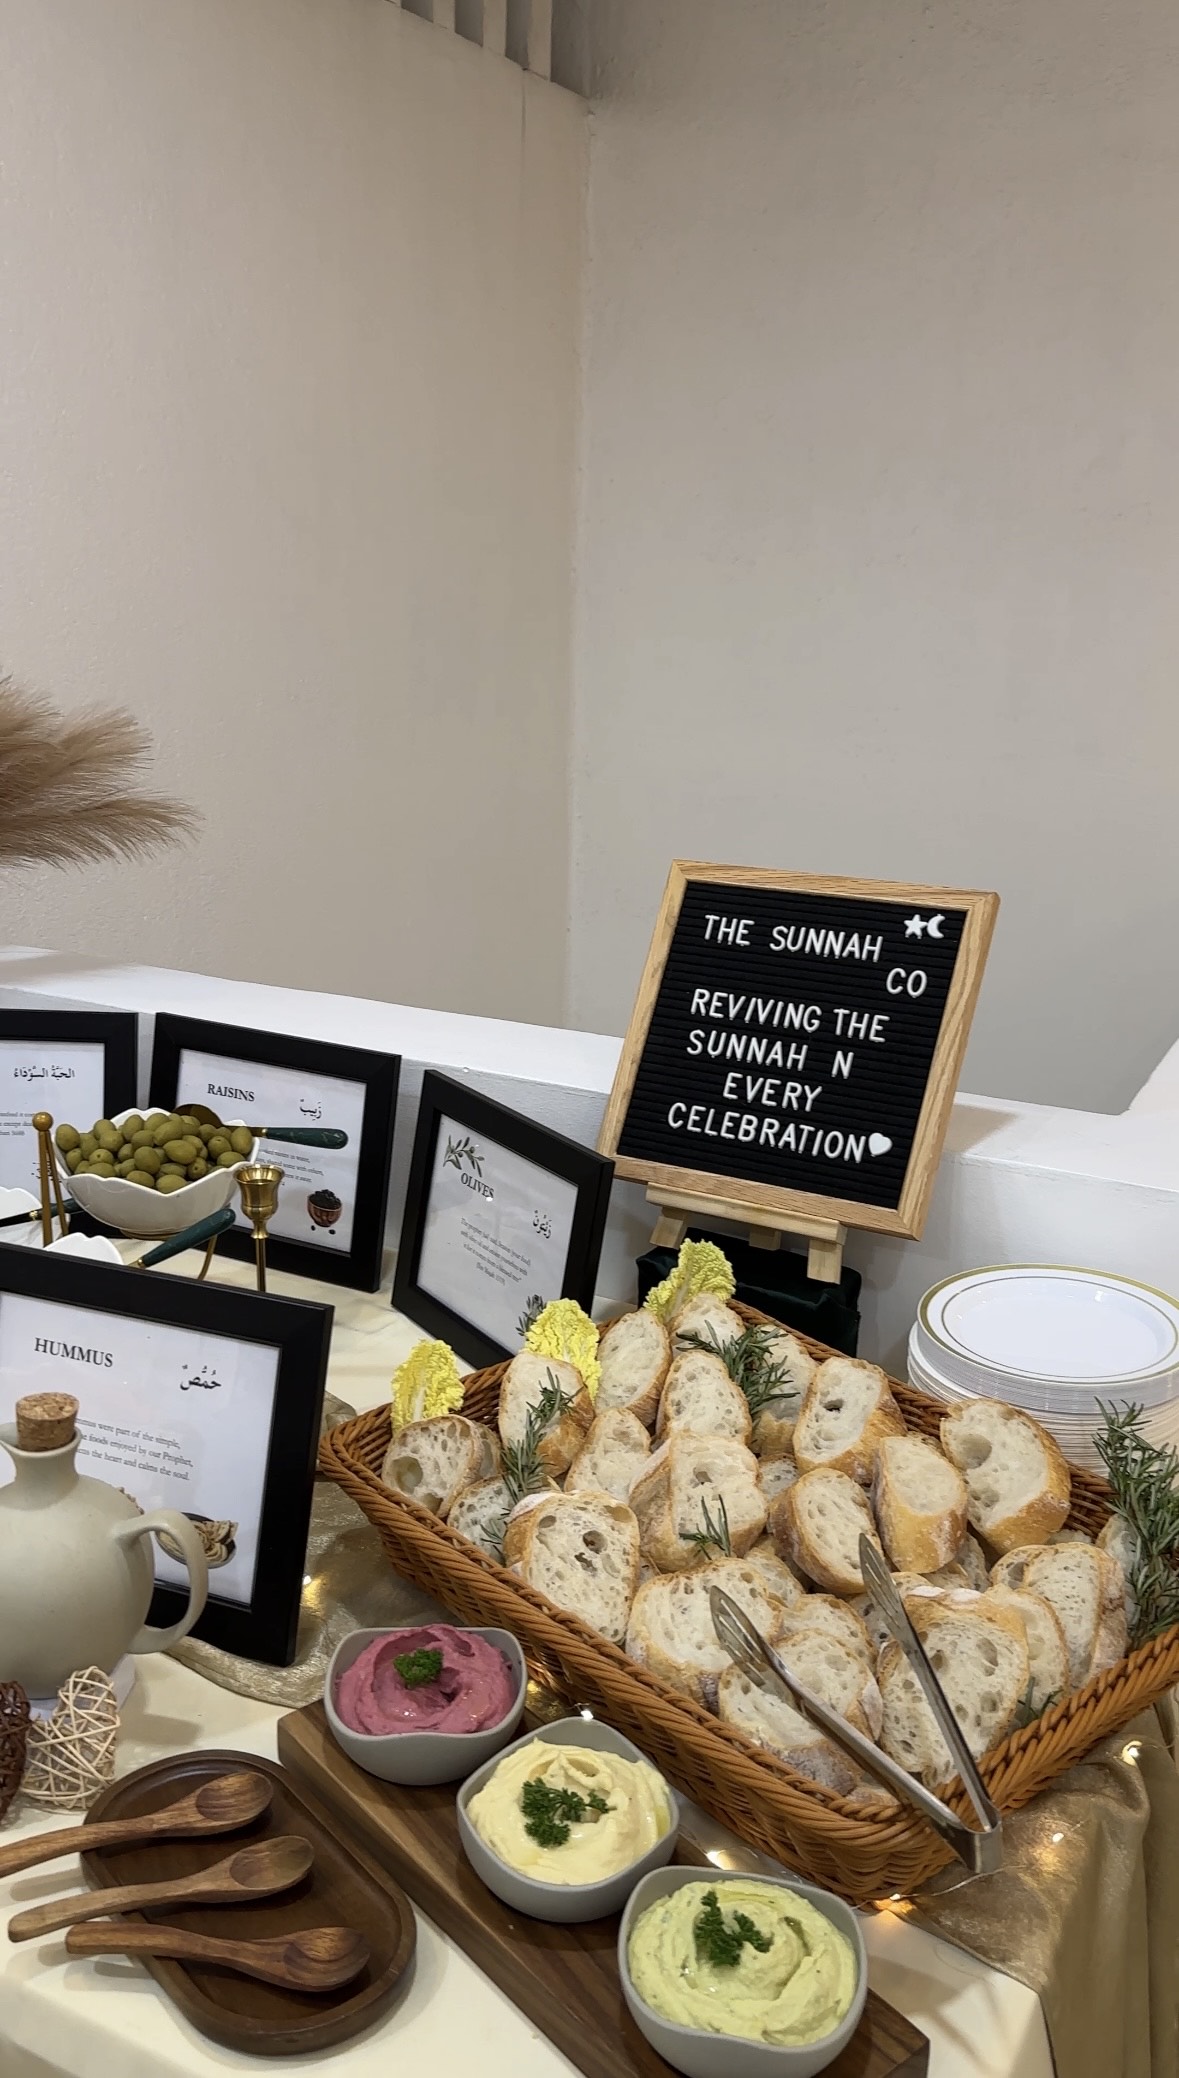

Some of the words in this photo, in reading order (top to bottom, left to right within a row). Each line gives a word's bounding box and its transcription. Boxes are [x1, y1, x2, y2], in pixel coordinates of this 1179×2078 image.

[704, 914, 755, 946] THE
[769, 926, 883, 962] SUNNAH
[886, 968, 928, 998] CO
[690, 988, 822, 1033] REVIVING
[833, 1008, 890, 1042] THE
[686, 1029, 808, 1071] SUNNAH
[831, 1050, 854, 1079] N
[207, 1083, 255, 1102] RAISINS
[722, 1072, 822, 1112] EVERY
[667, 1102, 866, 1163] CELEBRATION
[461, 1172, 494, 1198] OLIVES
[34, 1337, 114, 1368] HUMMUS
[89, 1434, 108, 1445] foods
[110, 1440, 137, 1453] enjoyed
[138, 1446, 147, 1457] by
[148, 1450, 161, 1459] our
[98, 1423, 114, 1432] were
[116, 1426, 130, 1436] part
[131, 1430, 141, 1438] of
[142, 1432, 154, 1442] the
[92, 1449, 102, 1459] the
[104, 1452, 122, 1464] heart
[123, 1459, 137, 1468] and
[160, 1466, 172, 1476] the
